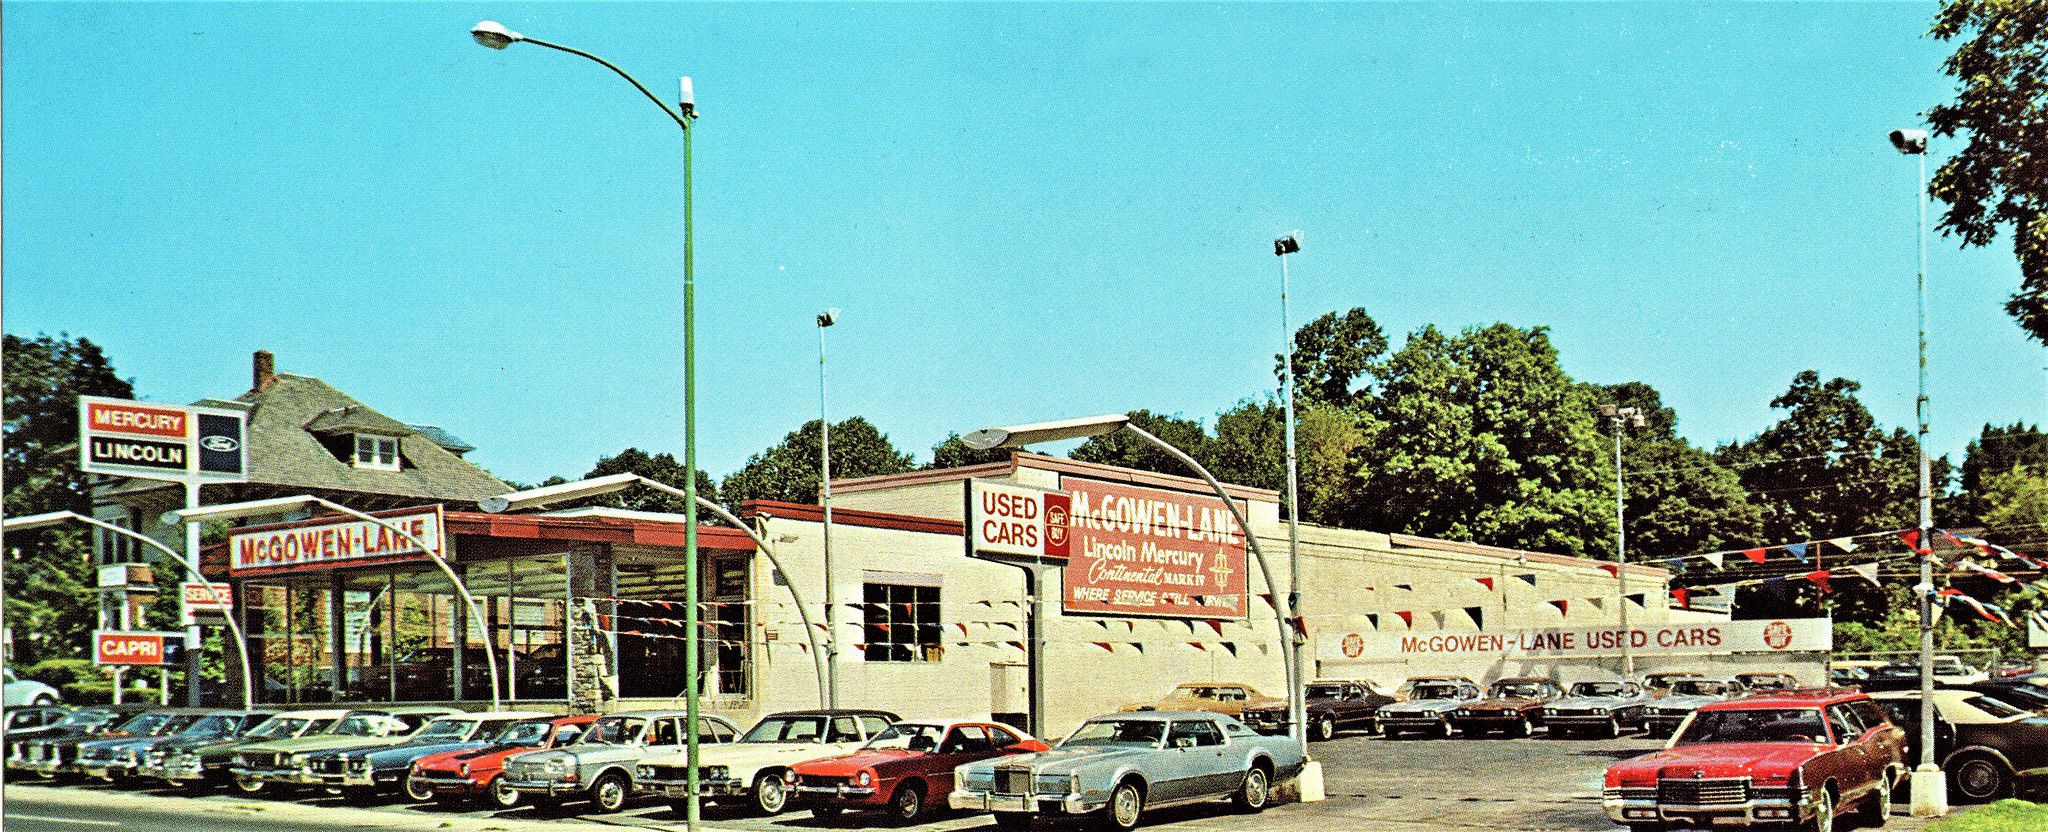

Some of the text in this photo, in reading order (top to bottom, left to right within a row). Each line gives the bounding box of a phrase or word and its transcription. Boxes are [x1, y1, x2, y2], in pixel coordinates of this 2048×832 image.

[94, 409, 182, 431] MERCURY
[95, 442, 182, 463] LINCOLN
[983, 491, 1037, 519] USED
[983, 520, 1038, 547] CARS
[1083, 535, 1204, 574] Lincoln Mercury
[1088, 557, 1165, 586] Continental
[1163, 572, 1194, 586] MARK
[1073, 586, 1110, 602] WHERE
[1113, 588, 1158, 604] SERVICE
[101, 640, 157, 656] CAPRI
[1401, 632, 1574, 653] McGOWEN-LANE
[1657, 627, 1722, 648] CARS
